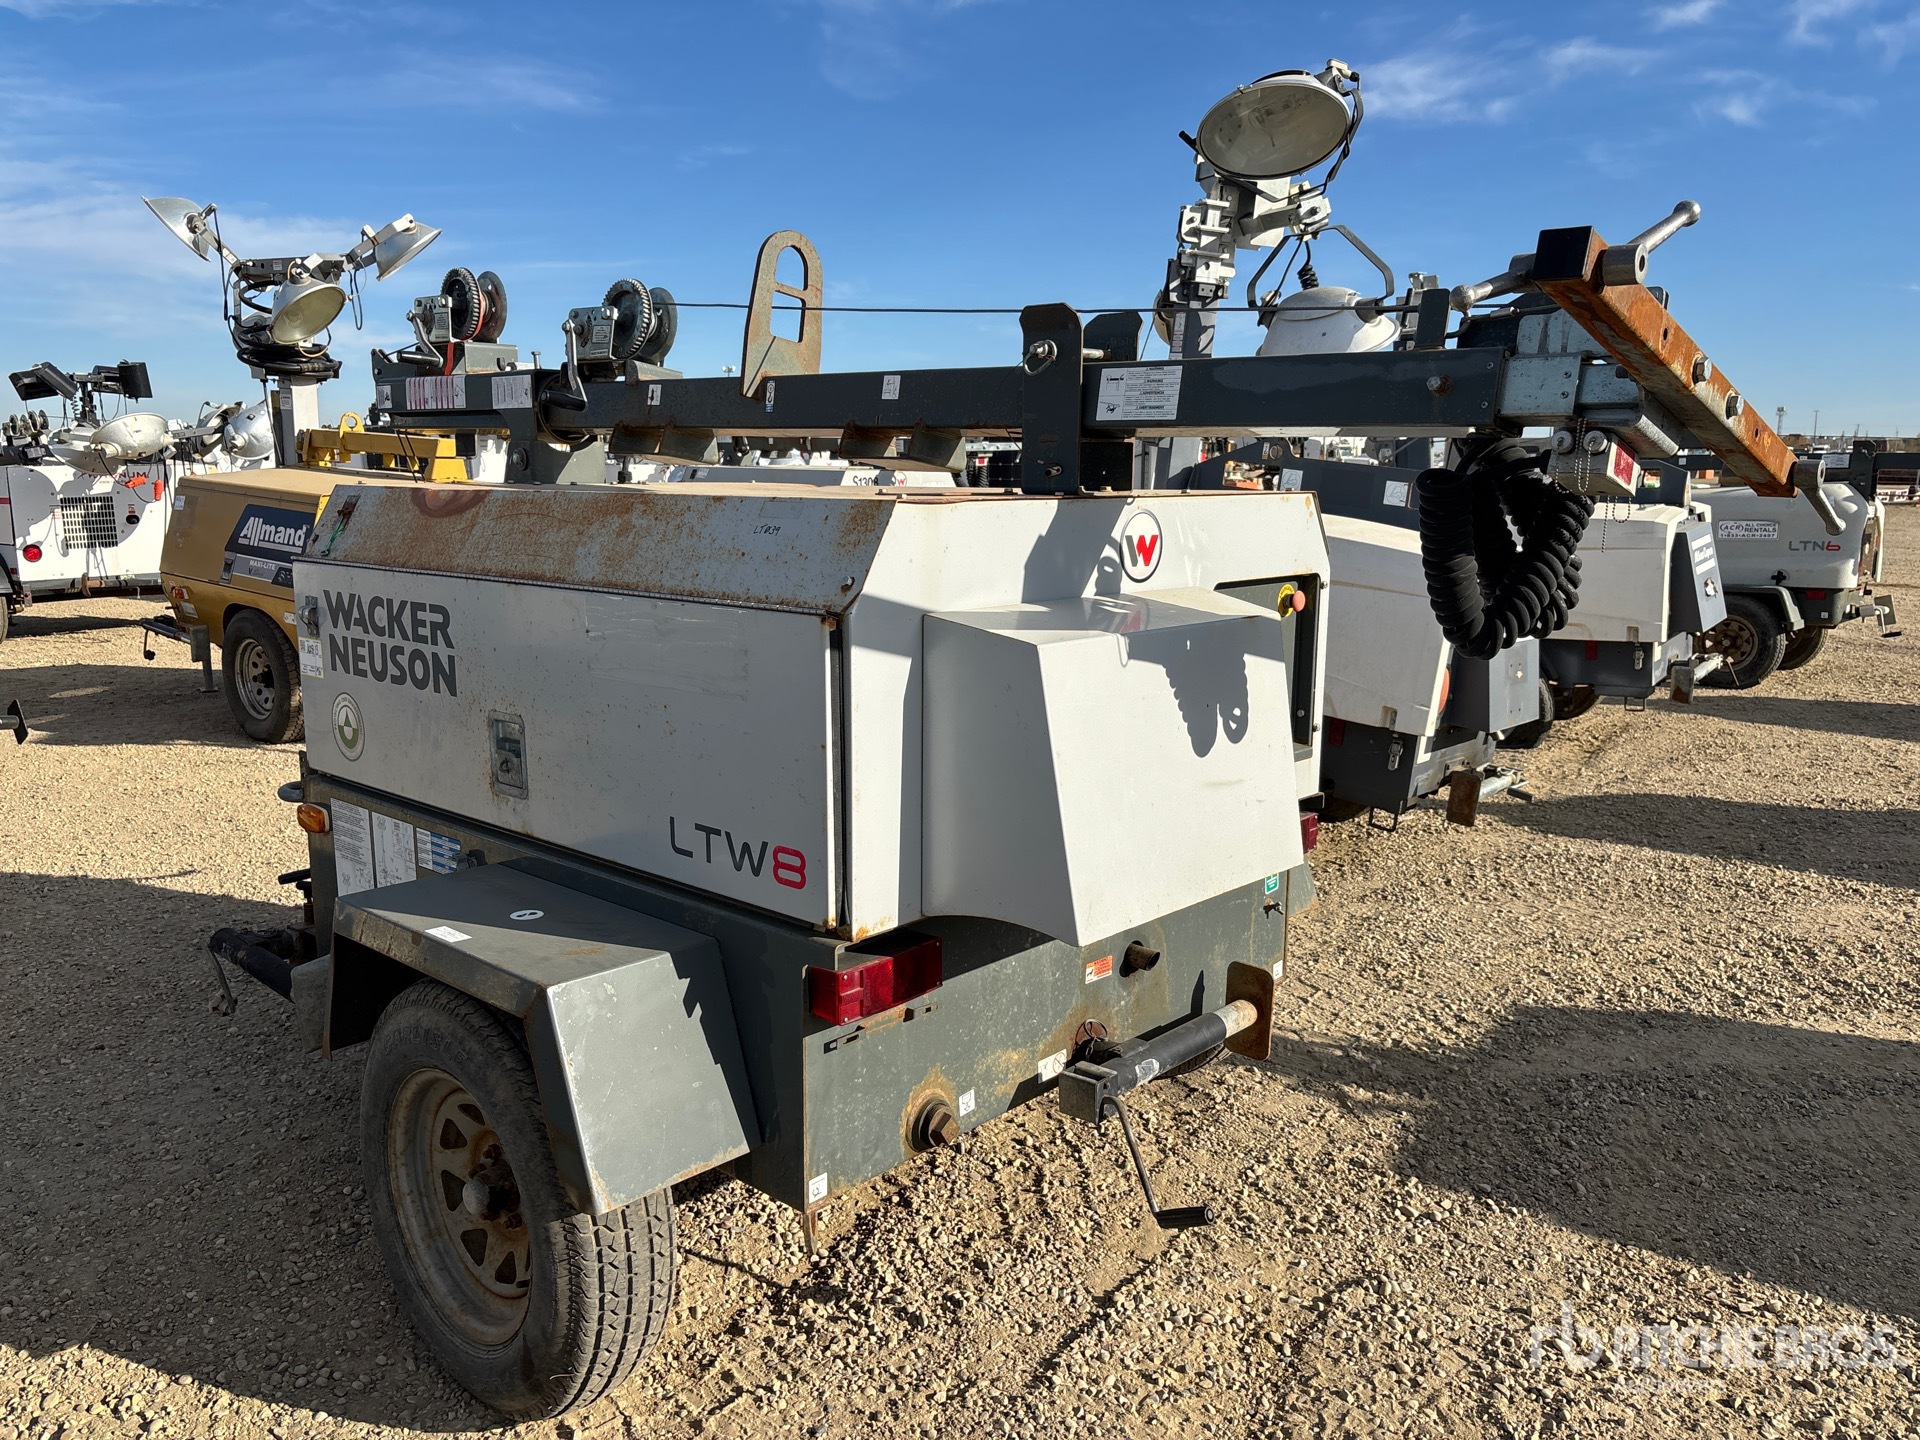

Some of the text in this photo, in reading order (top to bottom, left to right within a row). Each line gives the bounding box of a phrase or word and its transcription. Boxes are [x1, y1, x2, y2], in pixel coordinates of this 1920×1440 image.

[240, 516, 307, 547] Allmand
[1125, 535, 1159, 567] W
[1789, 541, 1841, 551] LTN6
[323, 589, 455, 649] WACKER
[329, 633, 457, 697] NEUSON
[669, 816, 807, 890] LTW8
